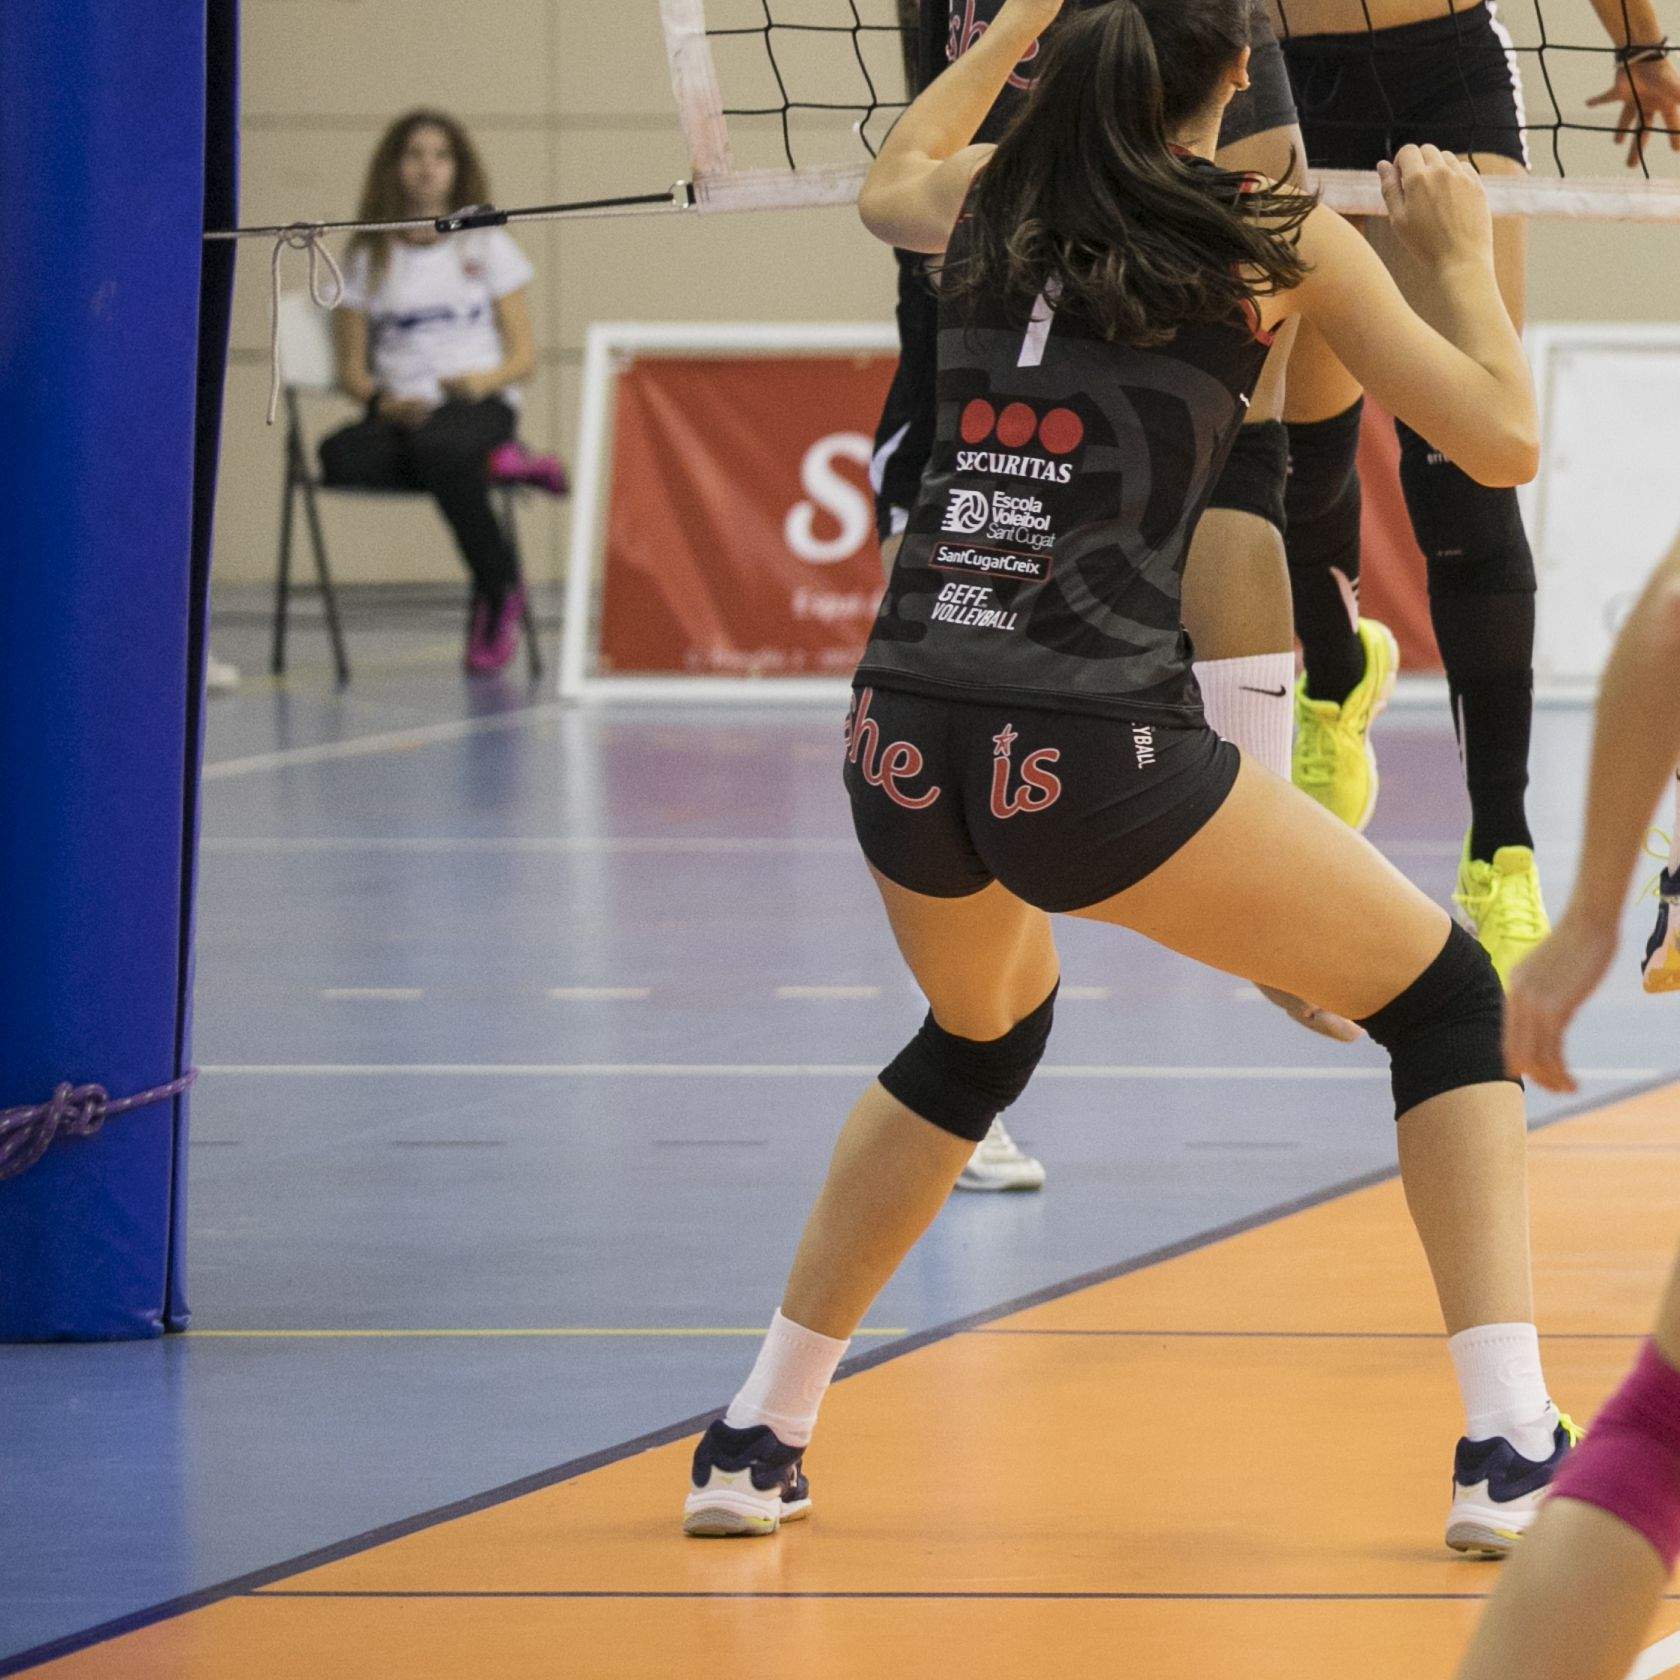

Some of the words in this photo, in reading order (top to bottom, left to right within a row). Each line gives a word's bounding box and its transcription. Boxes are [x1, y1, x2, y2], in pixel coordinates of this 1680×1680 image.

[956, 451, 1073, 483] SECURITAS
[992, 491, 1043, 513] Escola
[992, 506, 1051, 531] Voleibol
[986, 522, 1016, 541] Sant
[1015, 526, 1056, 551] Cugat
[937, 546, 1040, 575] SantCugatCreix
[931, 601, 1018, 630] VOLLEYBALL
[991, 723, 1061, 819] is
